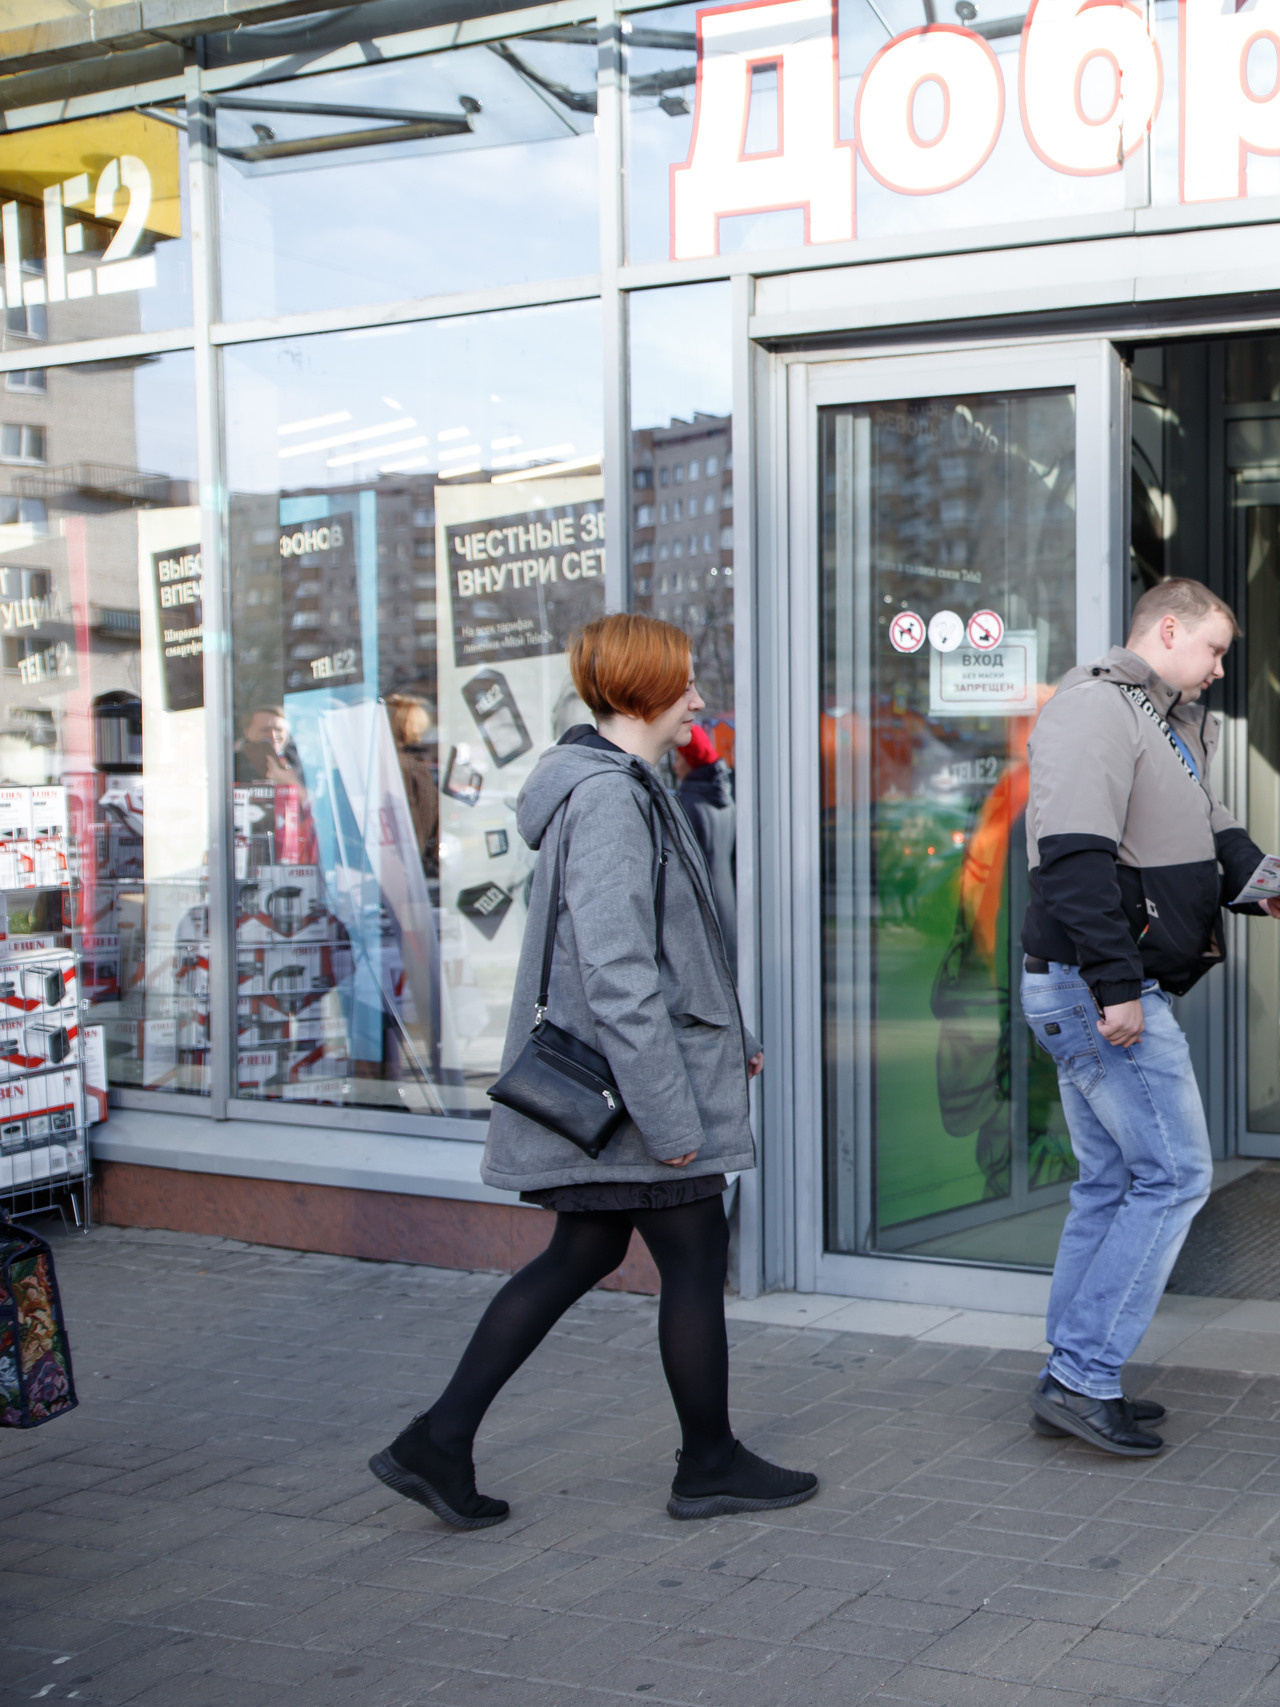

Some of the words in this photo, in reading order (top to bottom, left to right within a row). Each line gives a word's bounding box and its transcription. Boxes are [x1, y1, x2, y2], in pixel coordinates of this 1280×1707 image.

[454, 517, 576, 562] ЧЕСТНЫЕ
[456, 555, 558, 598] ВНУТРИ
[310, 648, 358, 680] TELE2
[962, 653, 1003, 668] ВХОД
[953, 682, 1014, 693] ЗАПРЕЩЕН
[951, 756, 997, 785] TELE2
